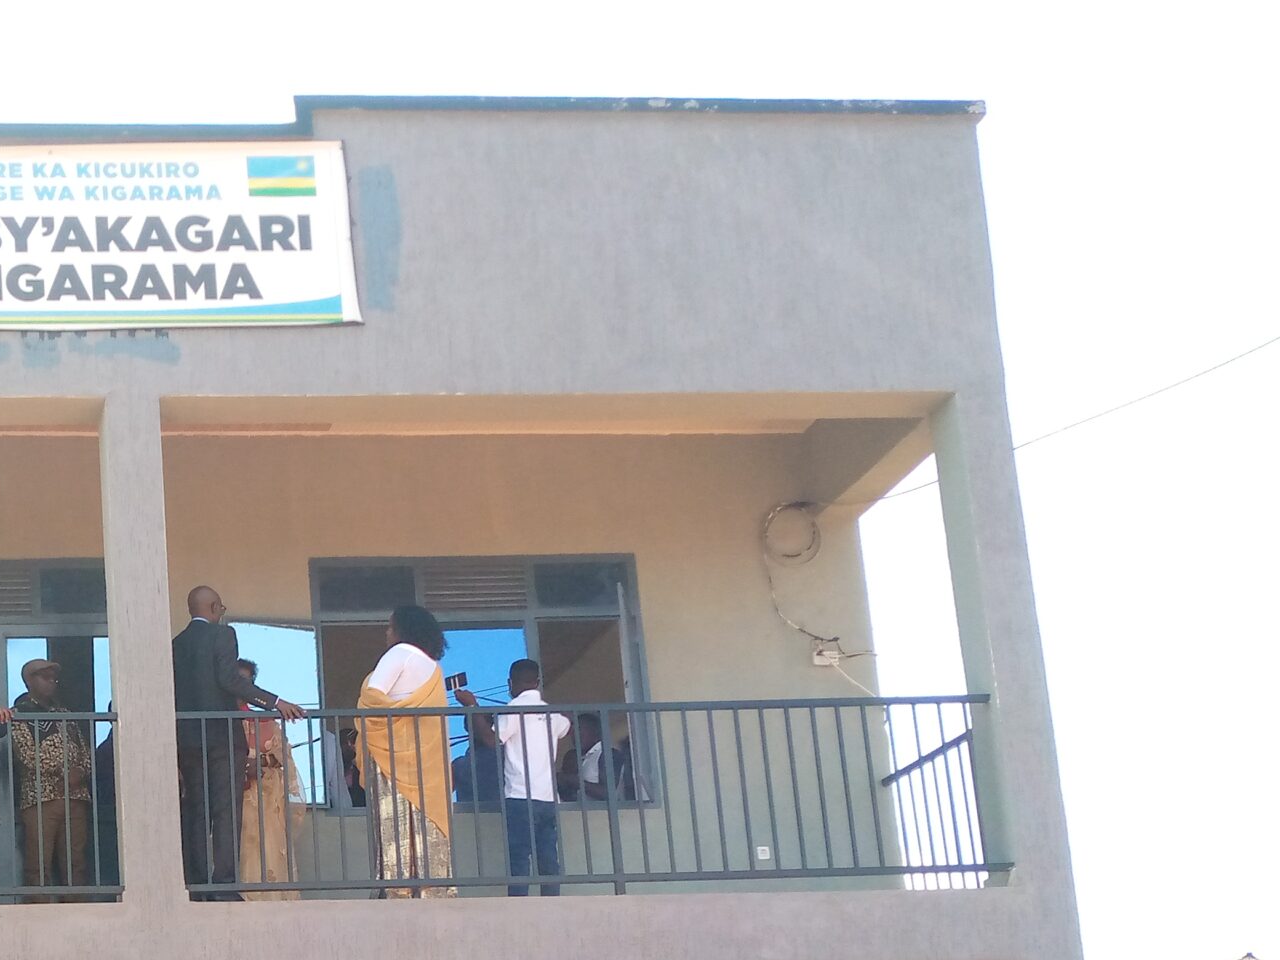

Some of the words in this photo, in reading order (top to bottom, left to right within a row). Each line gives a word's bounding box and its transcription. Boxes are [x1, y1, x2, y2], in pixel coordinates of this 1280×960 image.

[32, 163, 67, 178] KA
[76, 162, 200, 178] KICUKIRO
[32, 185, 76, 201] WA
[83, 184, 222, 201] KIGARAMA
